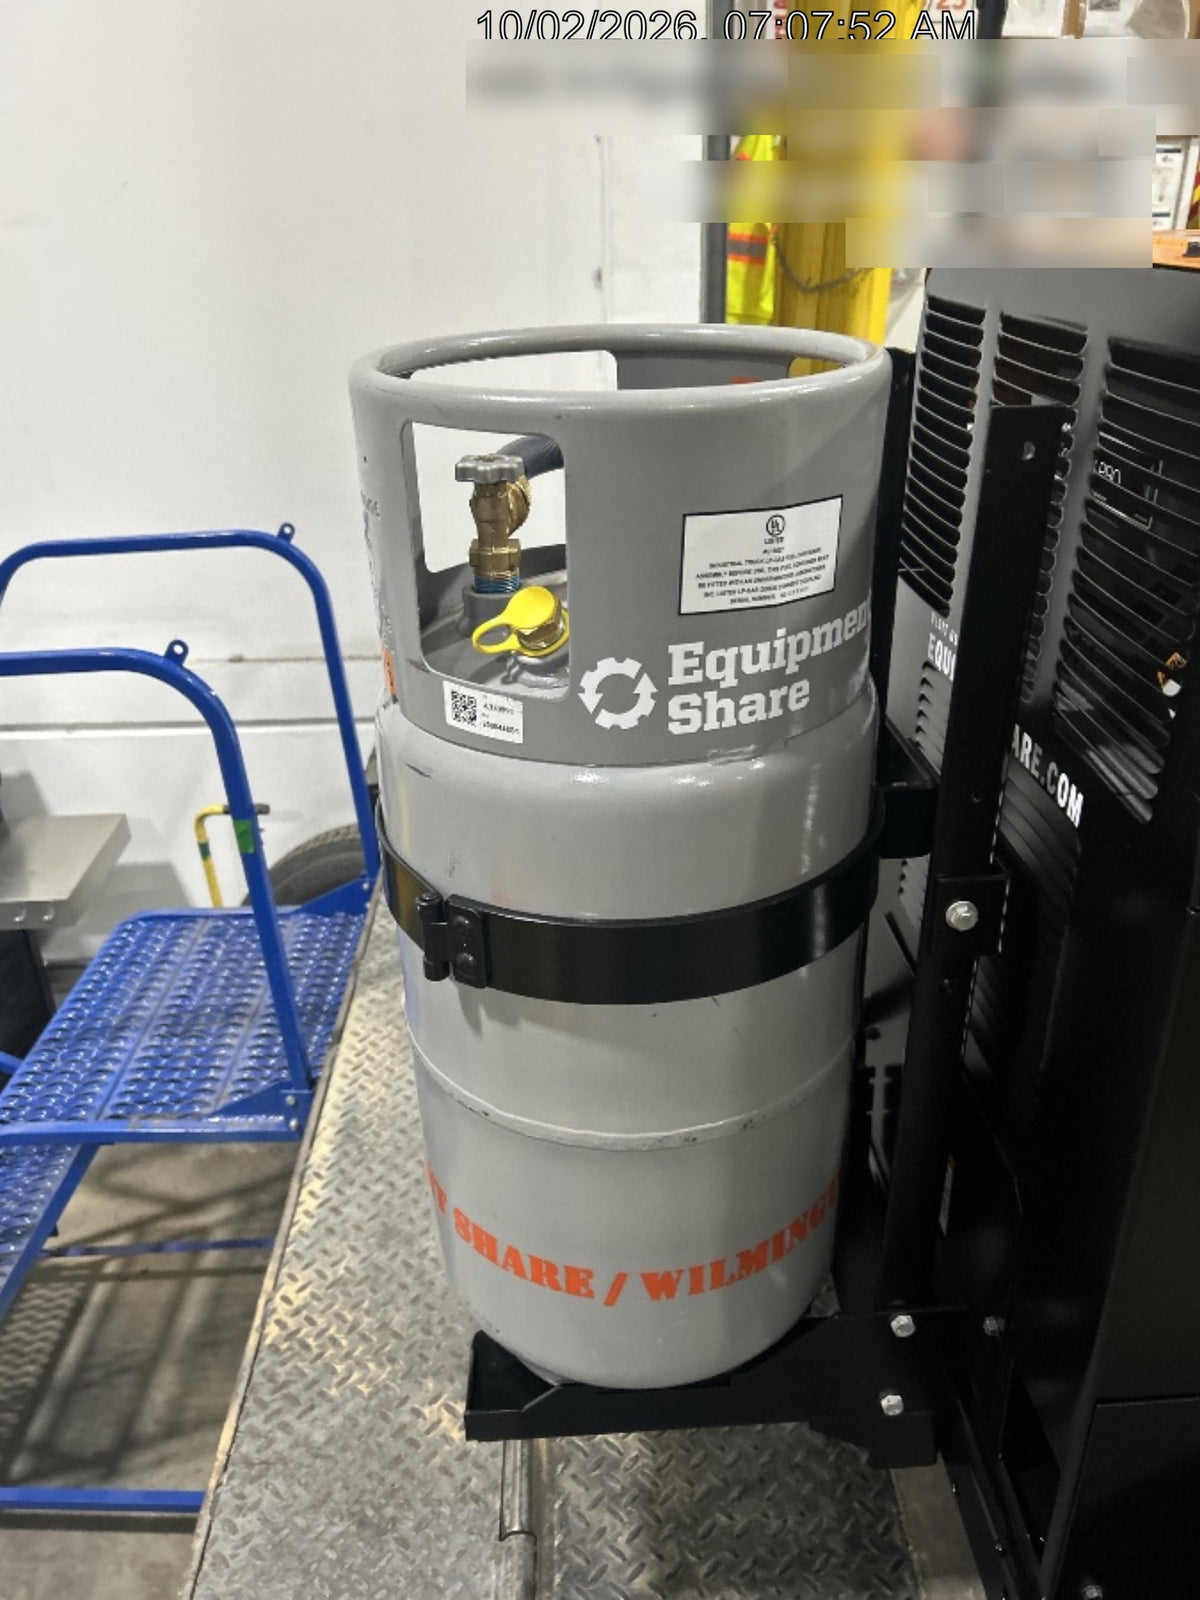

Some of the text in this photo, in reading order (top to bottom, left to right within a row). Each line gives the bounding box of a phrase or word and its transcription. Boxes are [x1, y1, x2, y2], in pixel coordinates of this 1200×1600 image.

[667, 680, 811, 735] Share
[453, 1206, 595, 1299] SHARE
[603, 1272, 628, 1307] /
